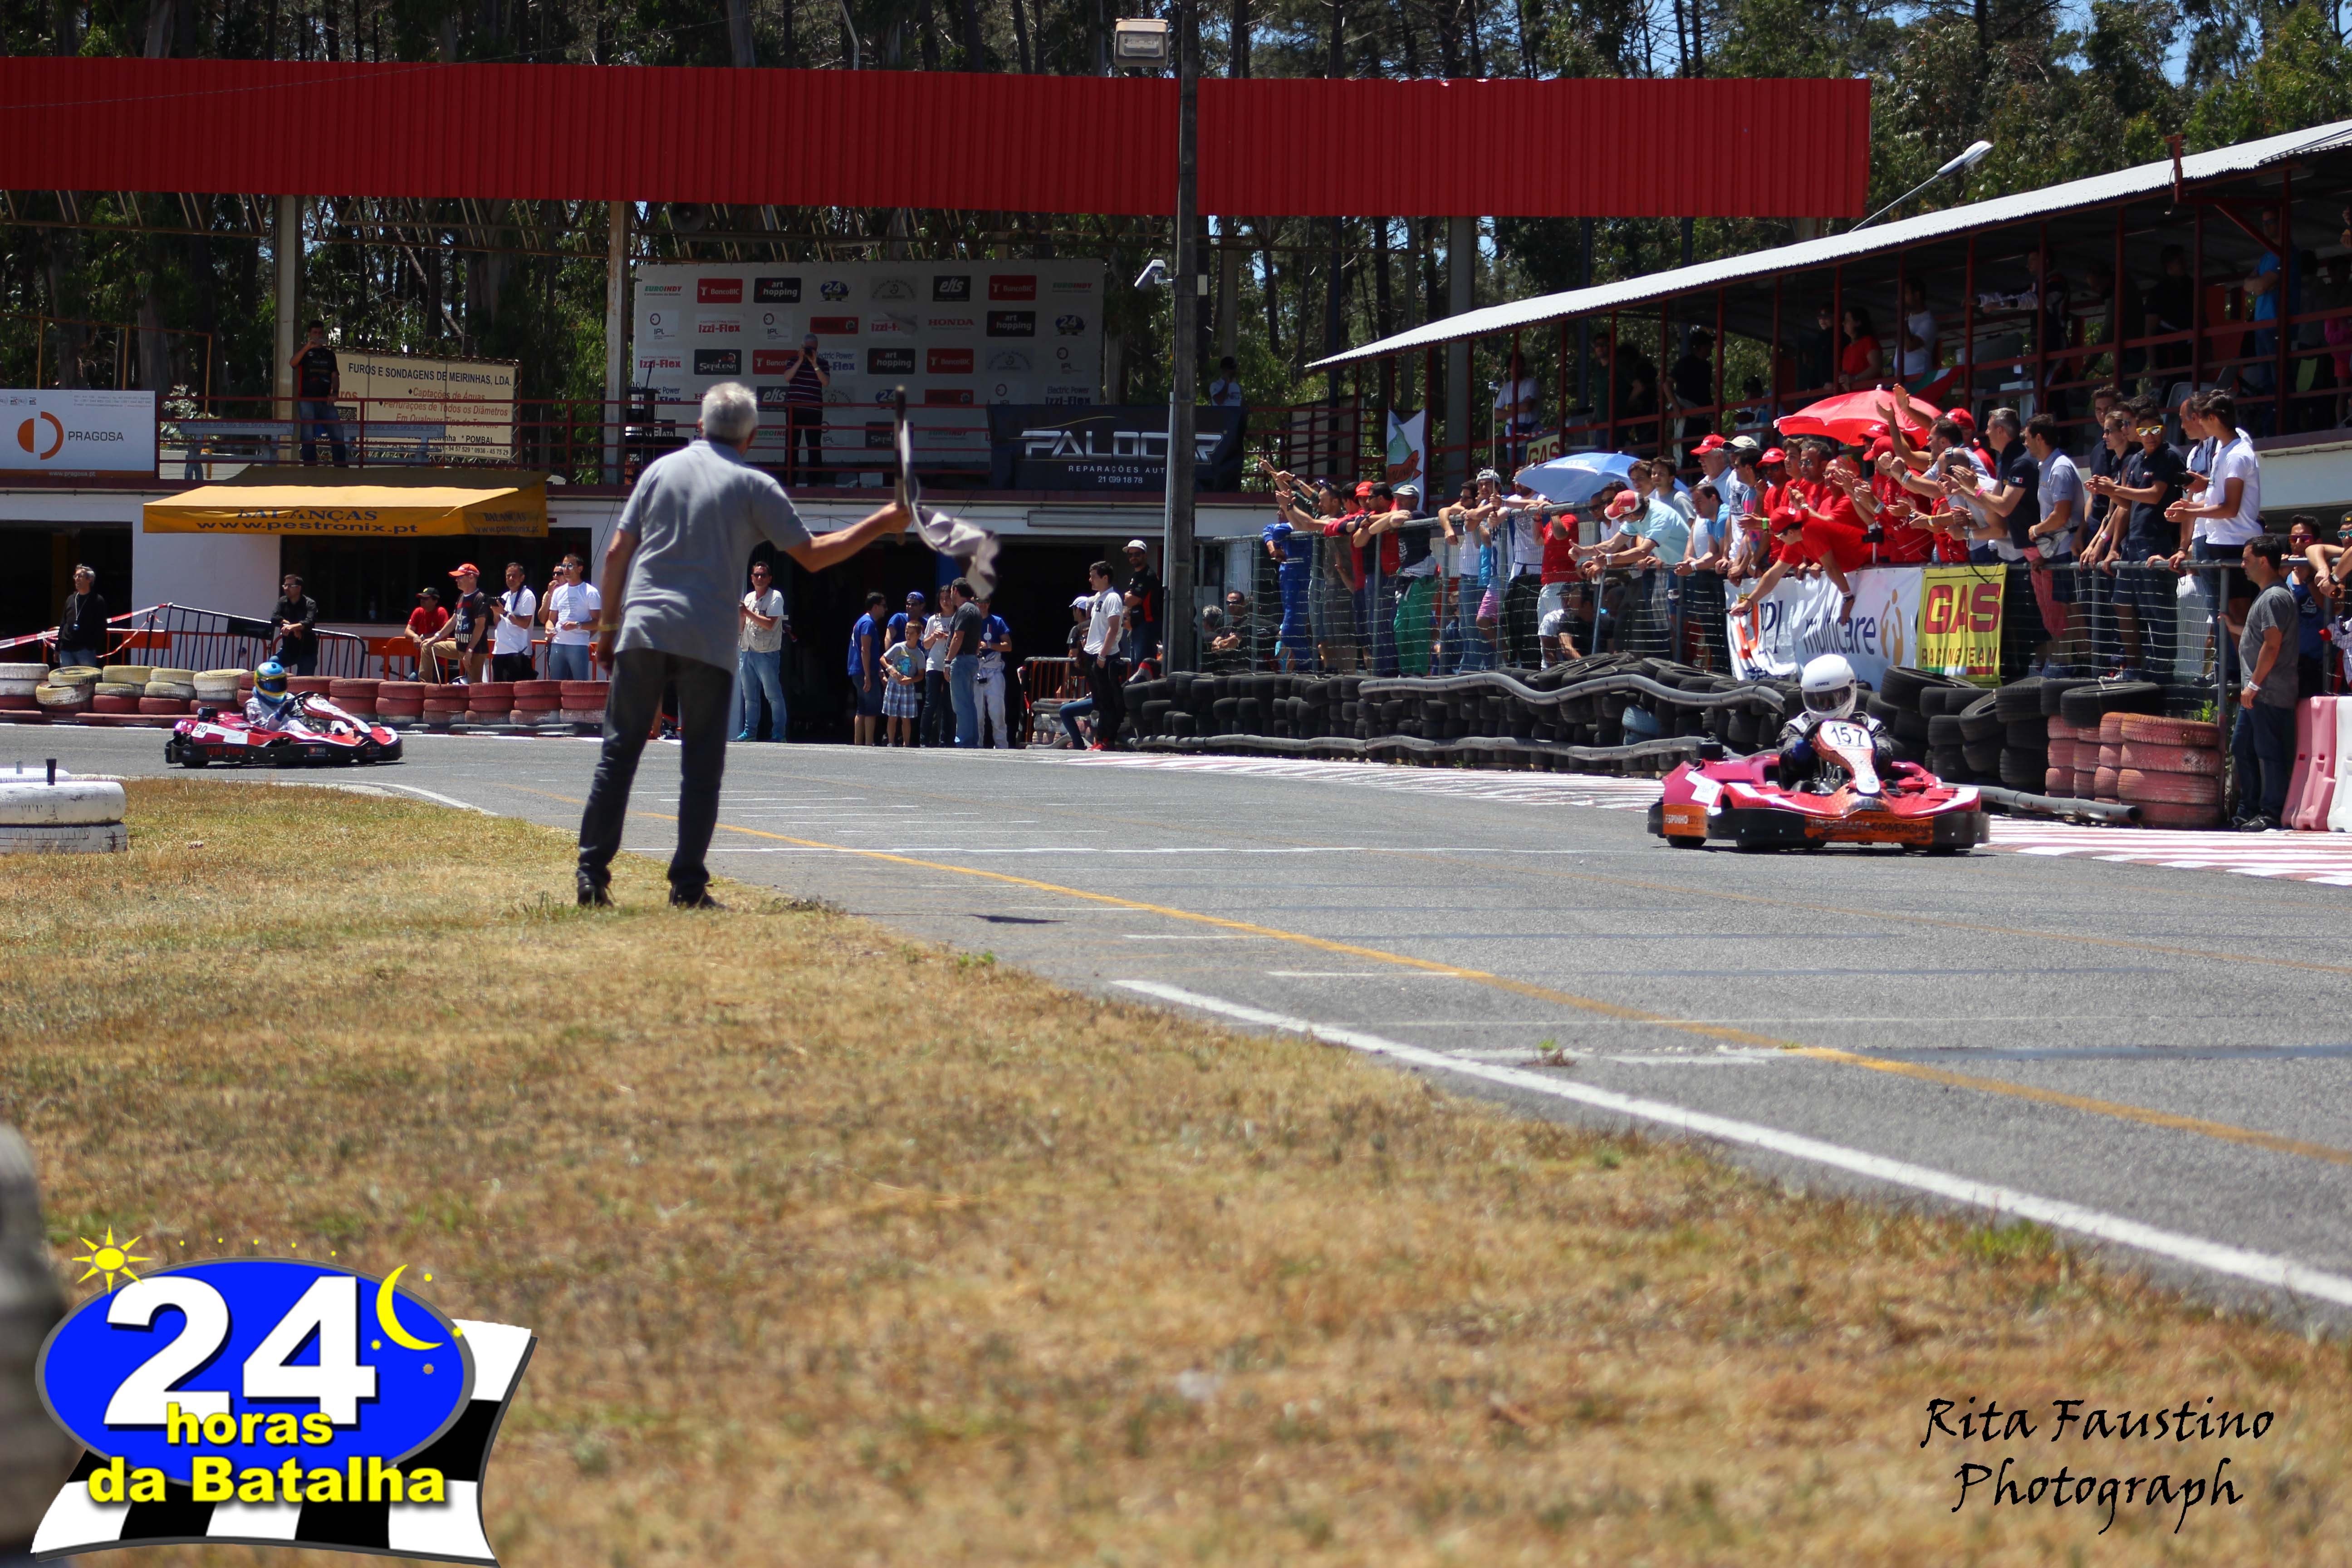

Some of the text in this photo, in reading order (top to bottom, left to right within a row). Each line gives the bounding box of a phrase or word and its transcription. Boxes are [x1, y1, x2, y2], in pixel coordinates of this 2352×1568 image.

[348, 363, 512, 386] FUROS E SONDAGENS DE MEIRINHAS, LDA.
[413, 387, 450, 400] Captações
[452, 391, 461, 400] de
[662, 386, 681, 394] Power
[428, 403, 437, 411] de
[440, 402, 461, 413] Todos
[473, 405, 509, 416] Diâmetros
[396, 413, 407, 421] Em
[68, 431, 124, 441] PRAGOSA
[466, 436, 494, 444] POMBAL
[1068, 465, 1139, 473] REPARAÇÕES
[196, 521, 418, 534] www.pestronix.pt
[1924, 583, 2001, 634] GAS
[1921, 647, 1961, 664] RACING
[195, 725, 208, 733] 90
[1831, 726, 1863, 745] 157
